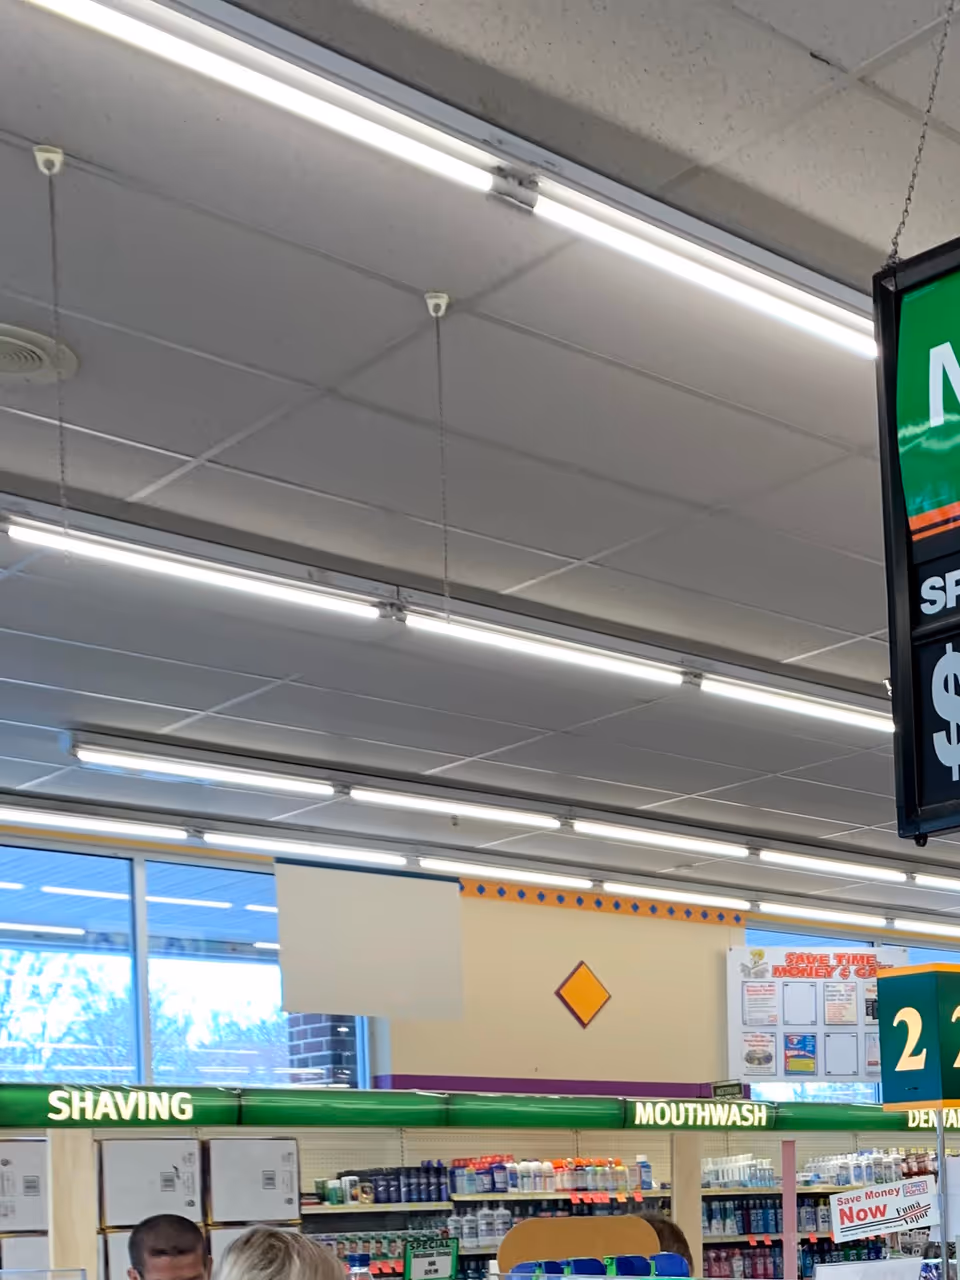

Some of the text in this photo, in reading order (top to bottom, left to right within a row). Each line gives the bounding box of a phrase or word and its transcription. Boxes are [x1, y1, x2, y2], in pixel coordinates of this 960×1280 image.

[784, 951, 831, 967] SAVE
[771, 964, 837, 980] MONEY
[838, 965, 852, 981] &
[892, 1006, 928, 1072] 2
[46, 1089, 194, 1121] SHAVING
[633, 1101, 769, 1128] MOUTHWASH
[836, 1186, 901, 1207] Save Money
[838, 1203, 888, 1226] Now
[896, 1200, 922, 1217] Fuma
[903, 1209, 930, 1226] Vapor
